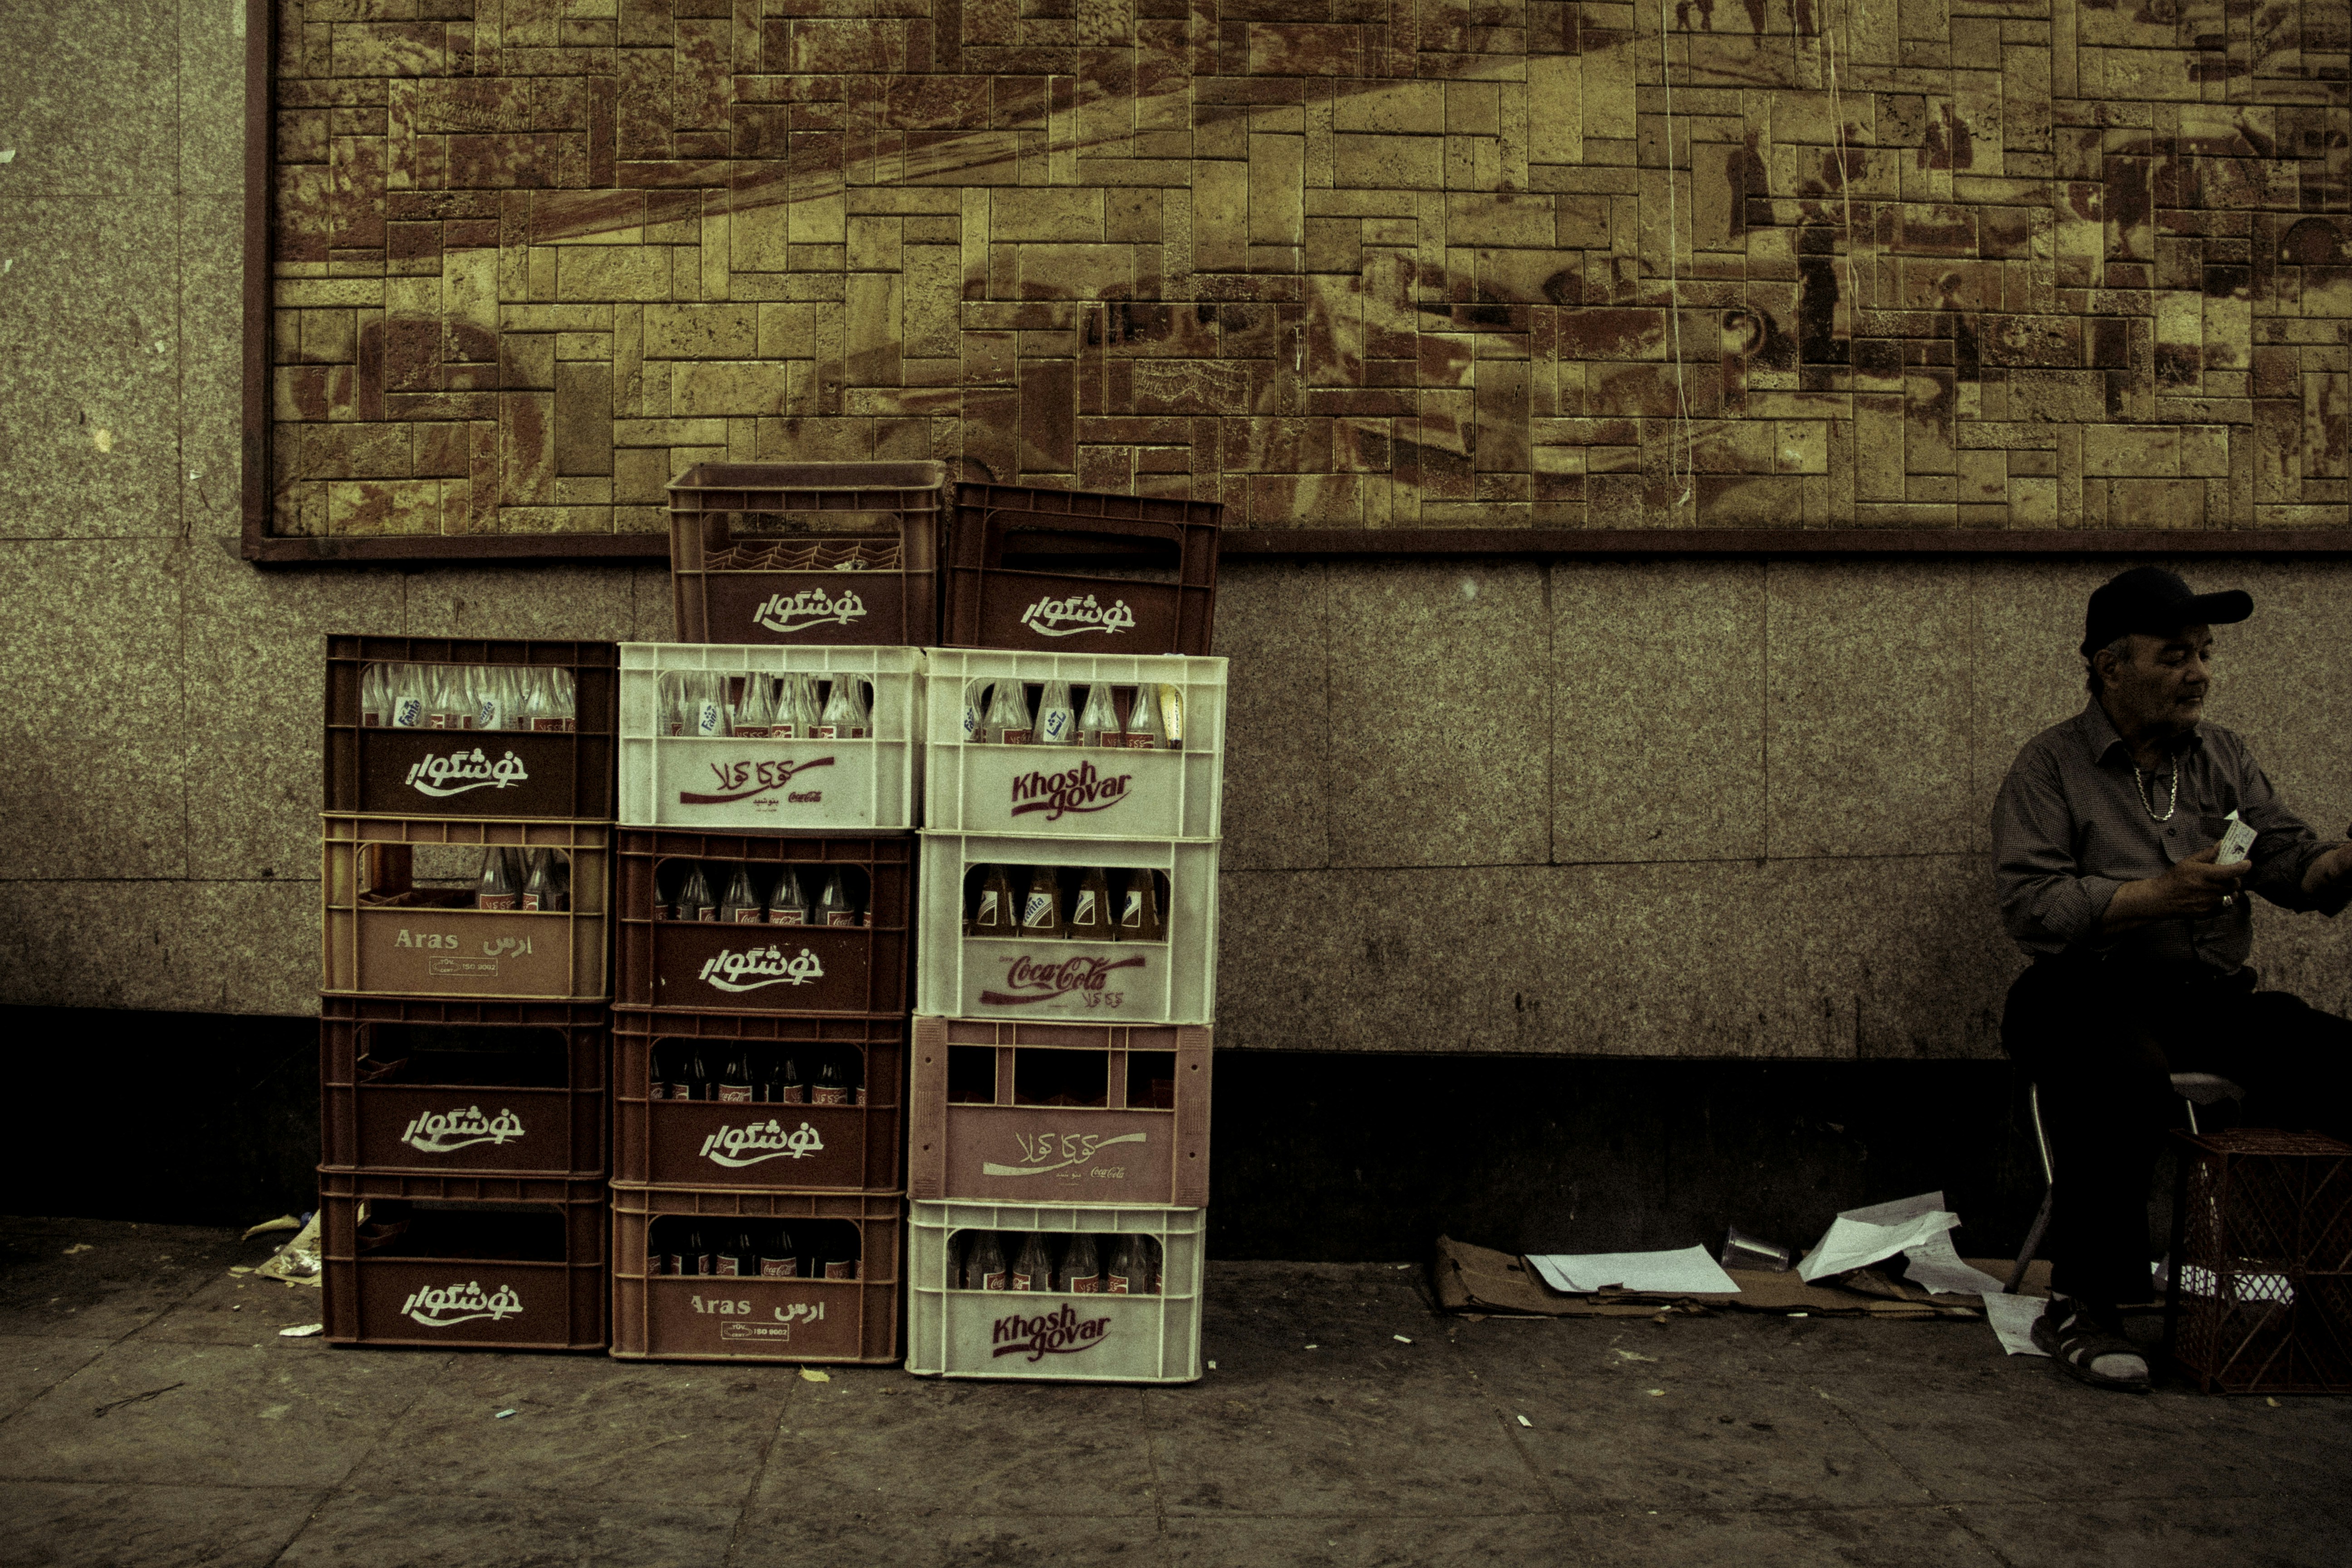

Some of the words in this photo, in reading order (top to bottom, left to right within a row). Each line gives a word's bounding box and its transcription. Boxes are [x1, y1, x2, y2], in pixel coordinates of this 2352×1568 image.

[753, 588, 867, 626] خوشگوار
[1020, 594, 1136, 634] خوشگوار
[405, 747, 529, 789] خوشگوار
[1011, 760, 1097, 802] Khosh
[1046, 774, 1132, 821] govar
[394, 929, 459, 949] Aras
[482, 934, 532, 959] ارس
[698, 944, 824, 986] خوشگوار
[1007, 955, 1111, 991] Coca-Cola
[401, 1105, 526, 1145] خوشگوار
[699, 1118, 824, 1160] خوشگوار
[1090, 1166, 1126, 1179] Coca-Cola
[401, 1280, 524, 1321] خوشگوار
[691, 1295, 751, 1315] Aras
[774, 1301, 825, 1324] ارس
[993, 1303, 1077, 1344] Khosh
[1027, 1318, 1111, 1362] govar
